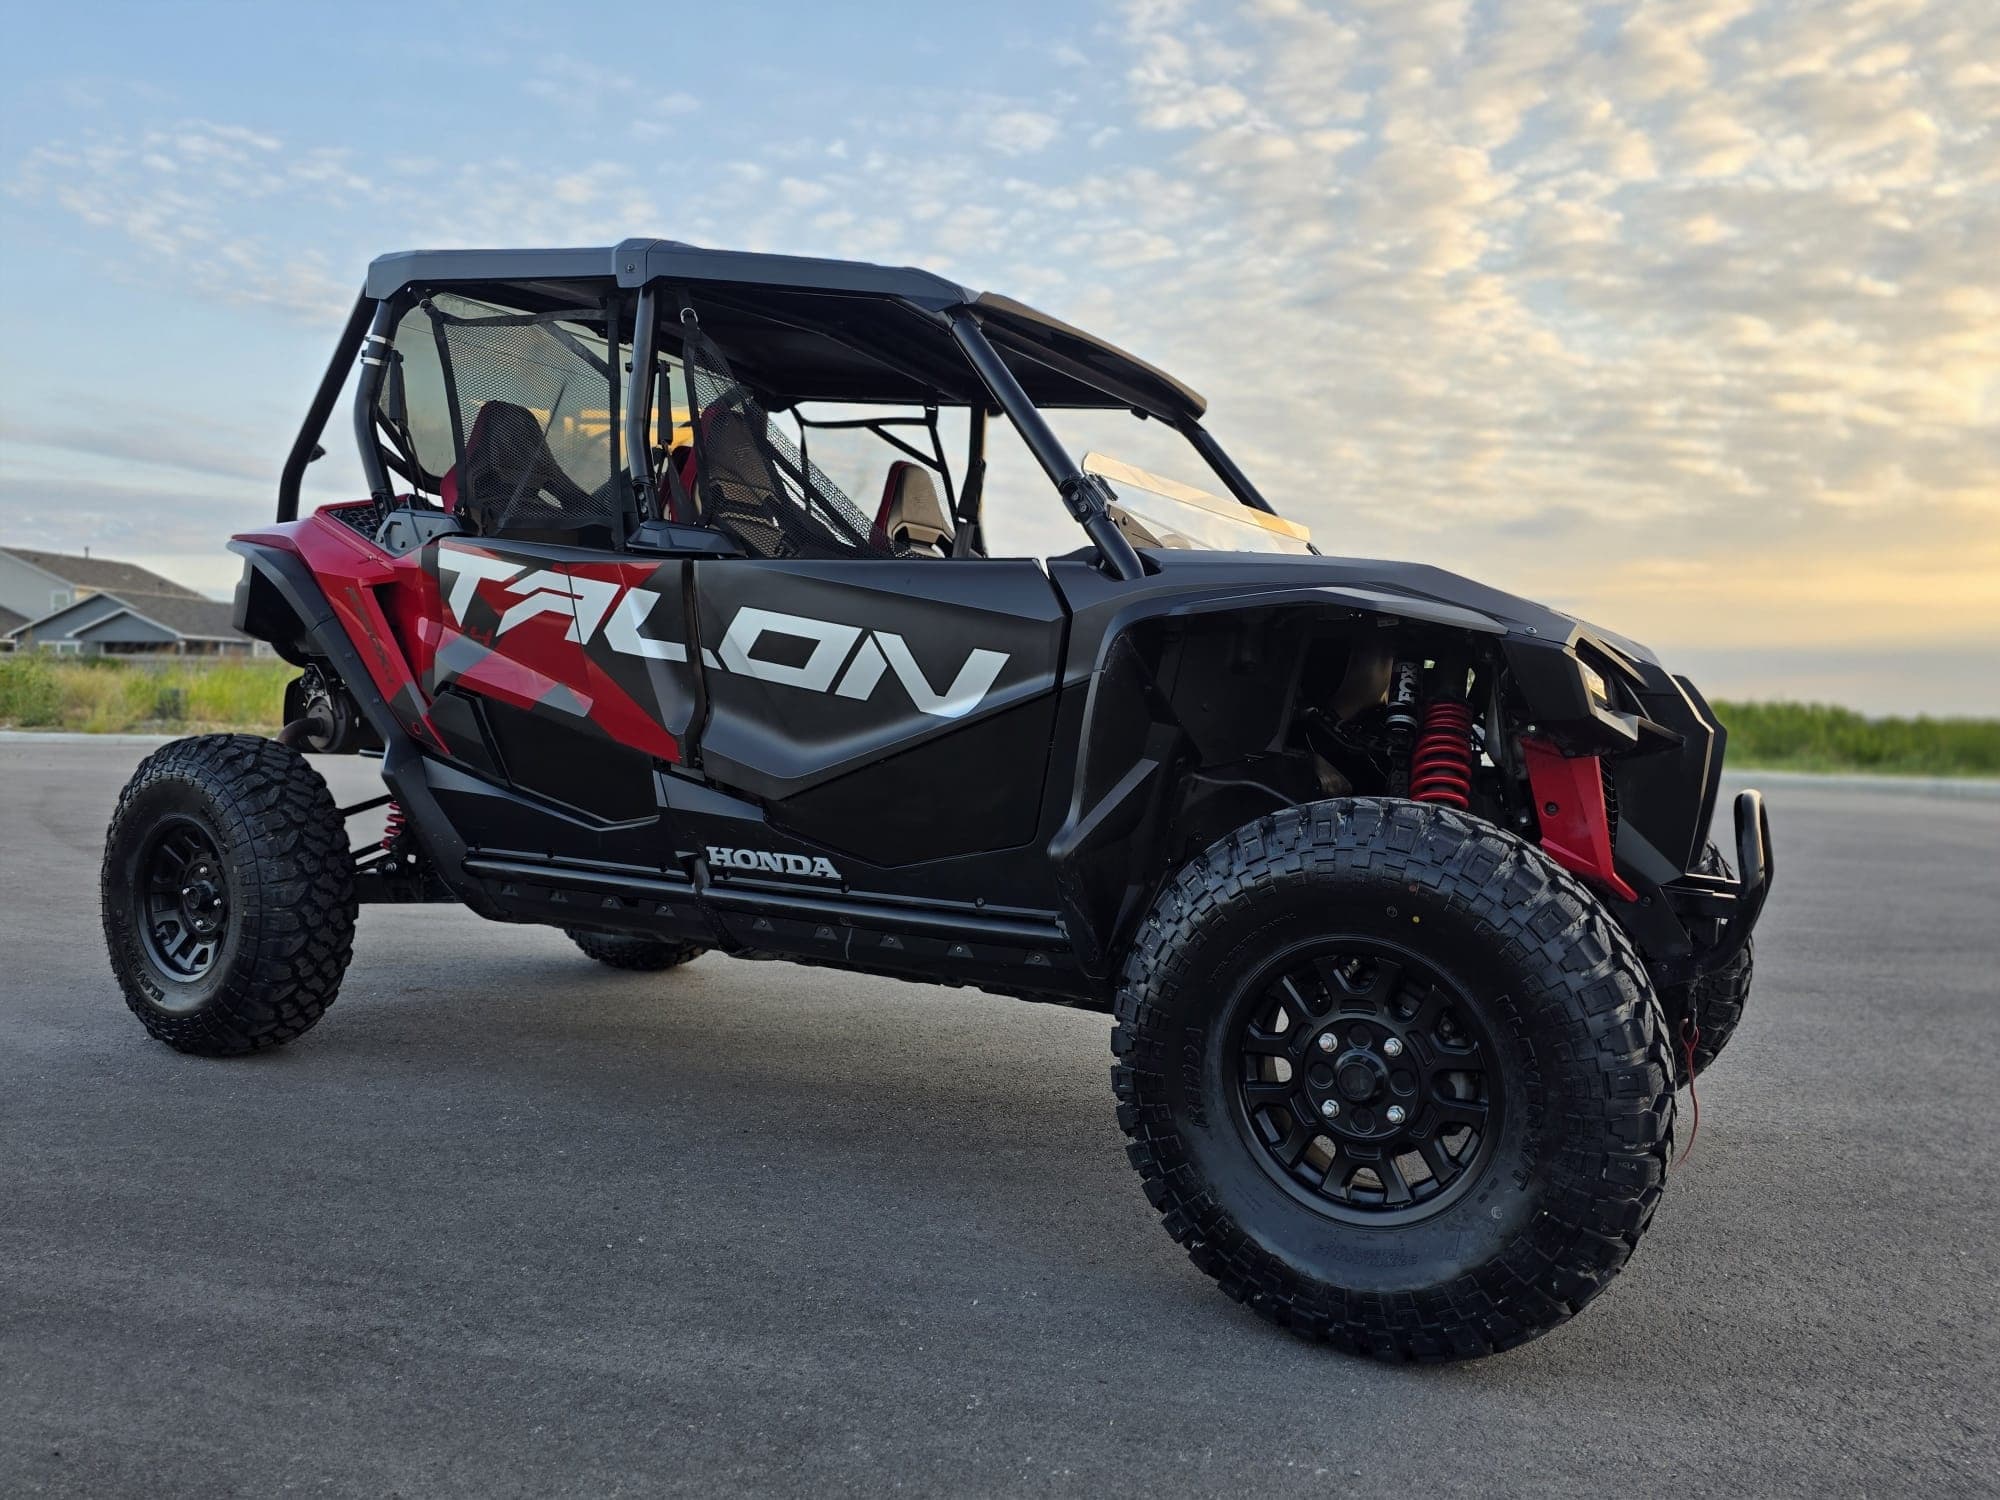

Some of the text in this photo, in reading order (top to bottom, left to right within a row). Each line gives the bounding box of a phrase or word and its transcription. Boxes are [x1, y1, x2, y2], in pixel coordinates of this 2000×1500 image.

[438, 547, 1010, 719] TALON
[1398, 664, 1417, 702] FOX
[706, 846, 842, 880] HONDA
